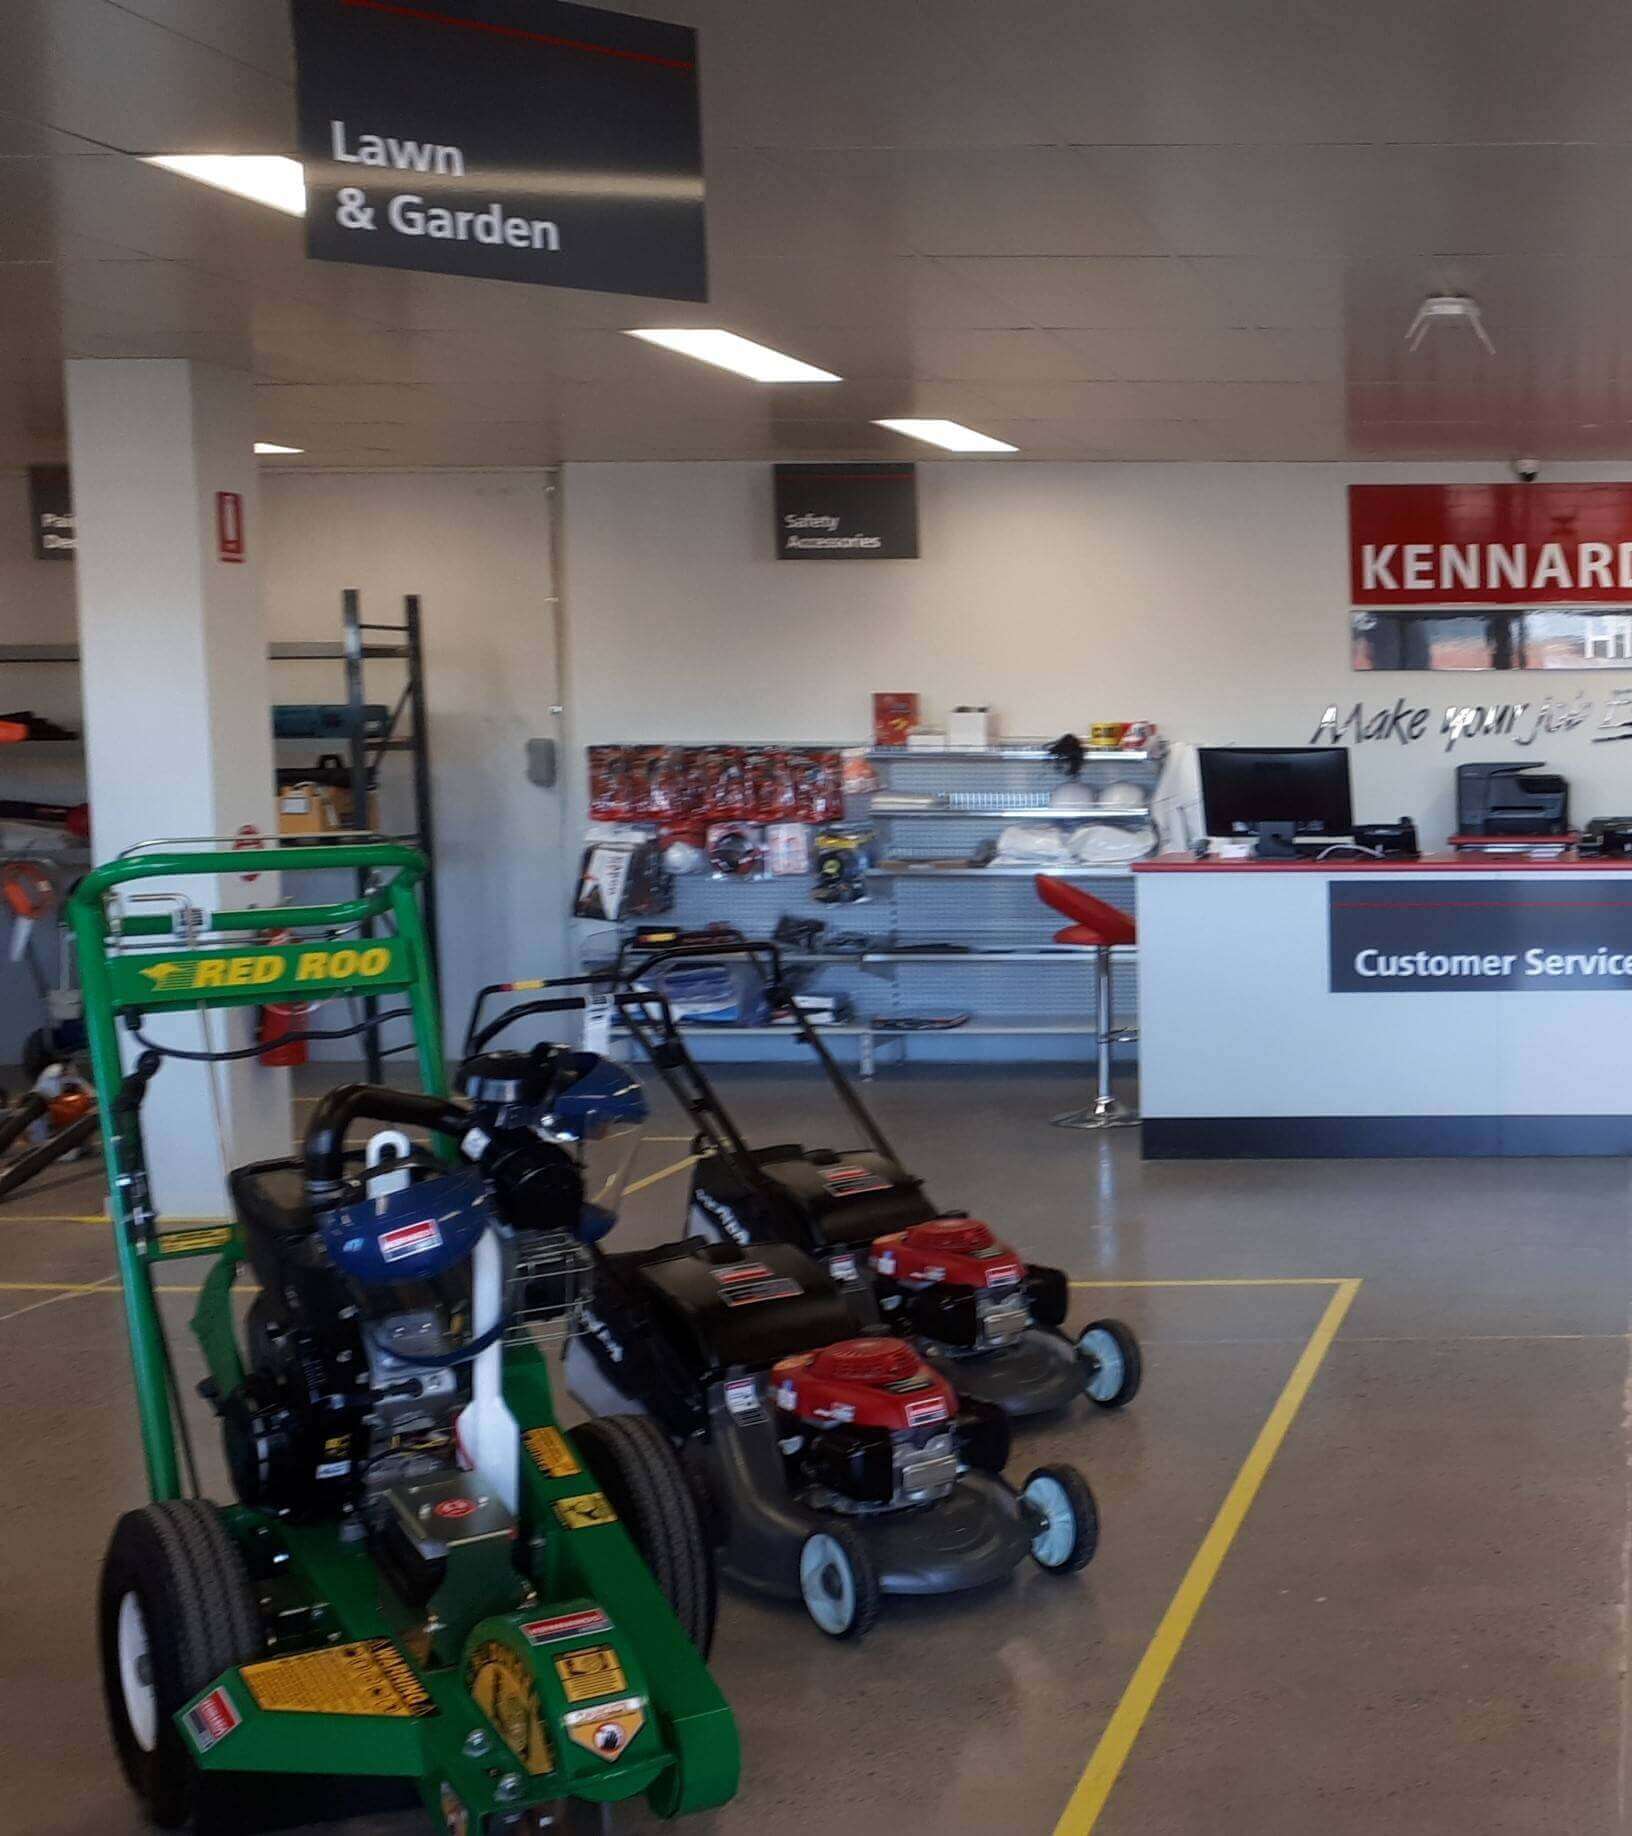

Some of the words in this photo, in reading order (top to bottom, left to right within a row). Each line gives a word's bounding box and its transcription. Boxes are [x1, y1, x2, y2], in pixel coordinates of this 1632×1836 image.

[330, 120, 465, 177] Lawn
[335, 187, 378, 231] &
[388, 194, 561, 250] Garden
[783, 512, 841, 532] Safety
[785, 533, 882, 549] Accessories
[1310, 697, 1430, 745] Make
[1440, 702, 1530, 753] your
[193, 954, 286, 988] RED
[295, 947, 392, 982] ROO
[1354, 948, 1517, 977] Customer
